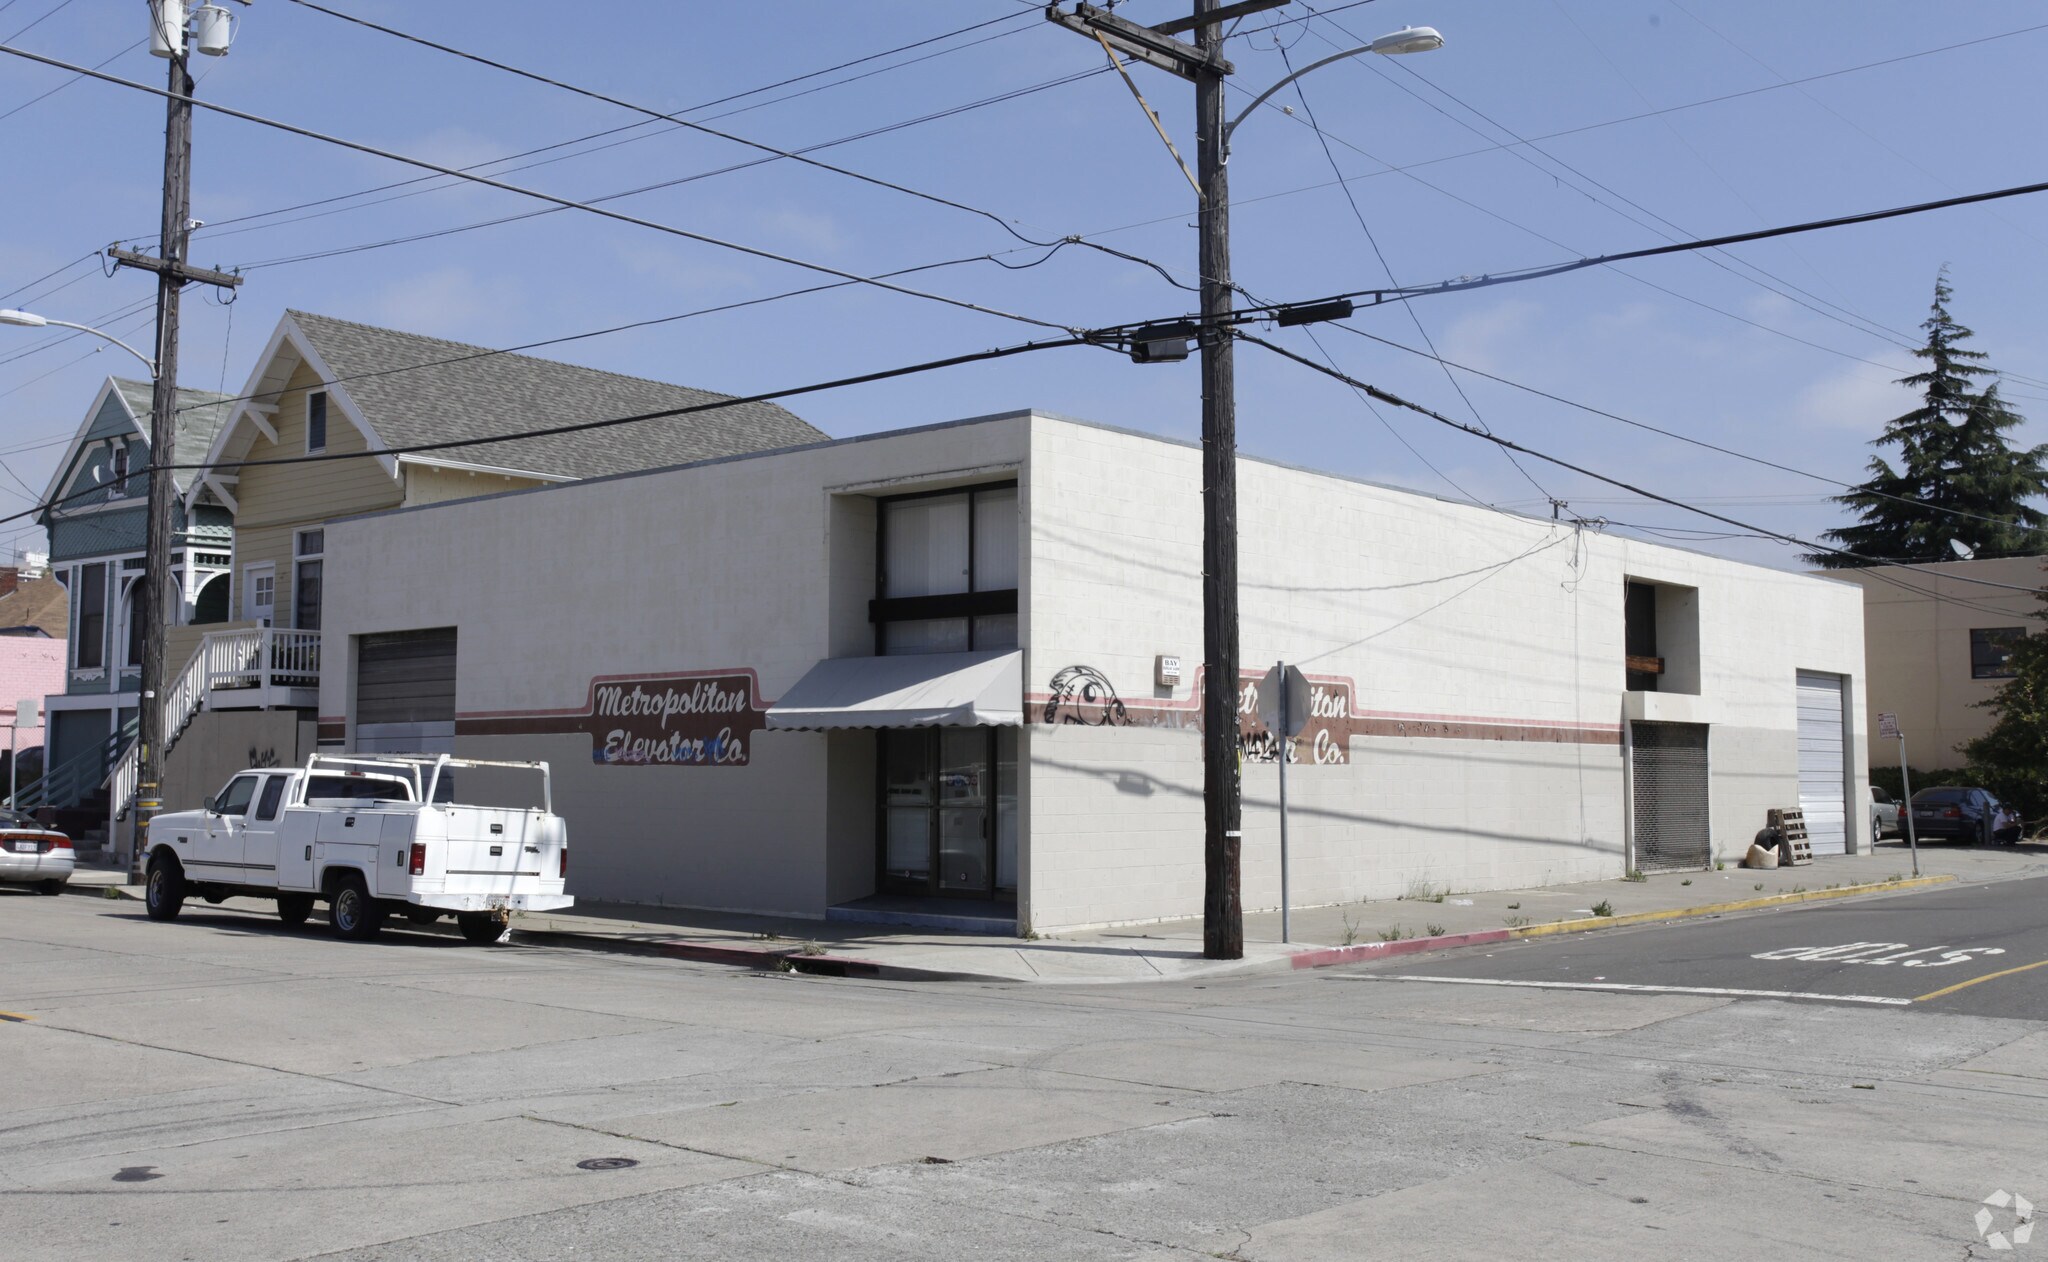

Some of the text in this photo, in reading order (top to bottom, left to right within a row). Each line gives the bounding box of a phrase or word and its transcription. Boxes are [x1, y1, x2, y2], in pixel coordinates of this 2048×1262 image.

[1164, 659, 1178, 667] BAY
[597, 681, 746, 730] Metropolitan
[604, 727, 746, 763] Elevator Co.
[1313, 729, 1345, 764] Co.
